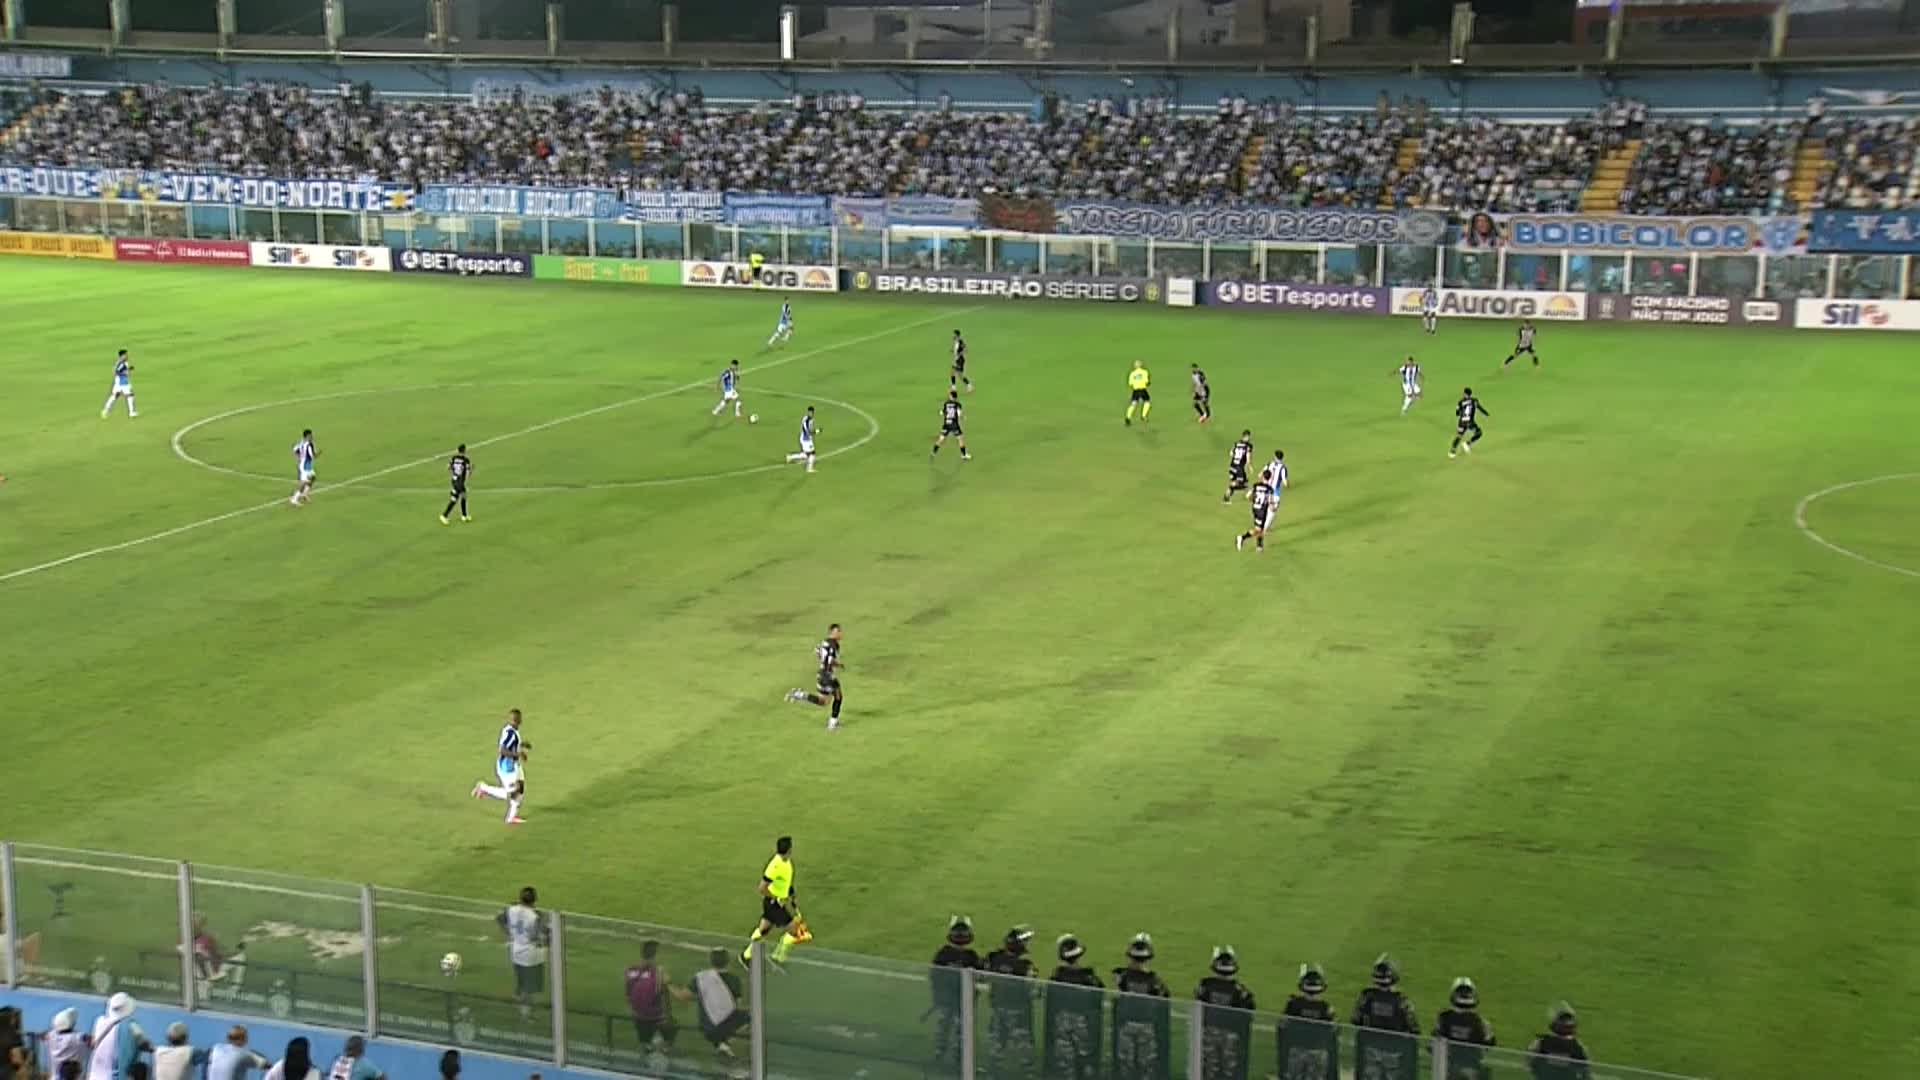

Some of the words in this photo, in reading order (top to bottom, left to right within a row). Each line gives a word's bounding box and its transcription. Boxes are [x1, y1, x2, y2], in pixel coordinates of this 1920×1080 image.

[34, 168, 88, 197] QUE
[172, 174, 239, 202] VEM
[243, 179, 277, 205] DO
[288, 180, 382, 210] NORTE
[1070, 205, 1183, 237] TORCIDA
[421, 251, 524, 276] BETesporte
[720, 265, 799, 287] Auora
[876, 273, 1042, 297] BRASILEIRÃO
[1046, 280, 1117, 300] SÉRIE
[1119, 284, 1139, 300] C
[1243, 285, 1376, 309] BETesporte
[1442, 291, 1537, 316] Aurora
[1822, 303, 1859, 324] Sil
